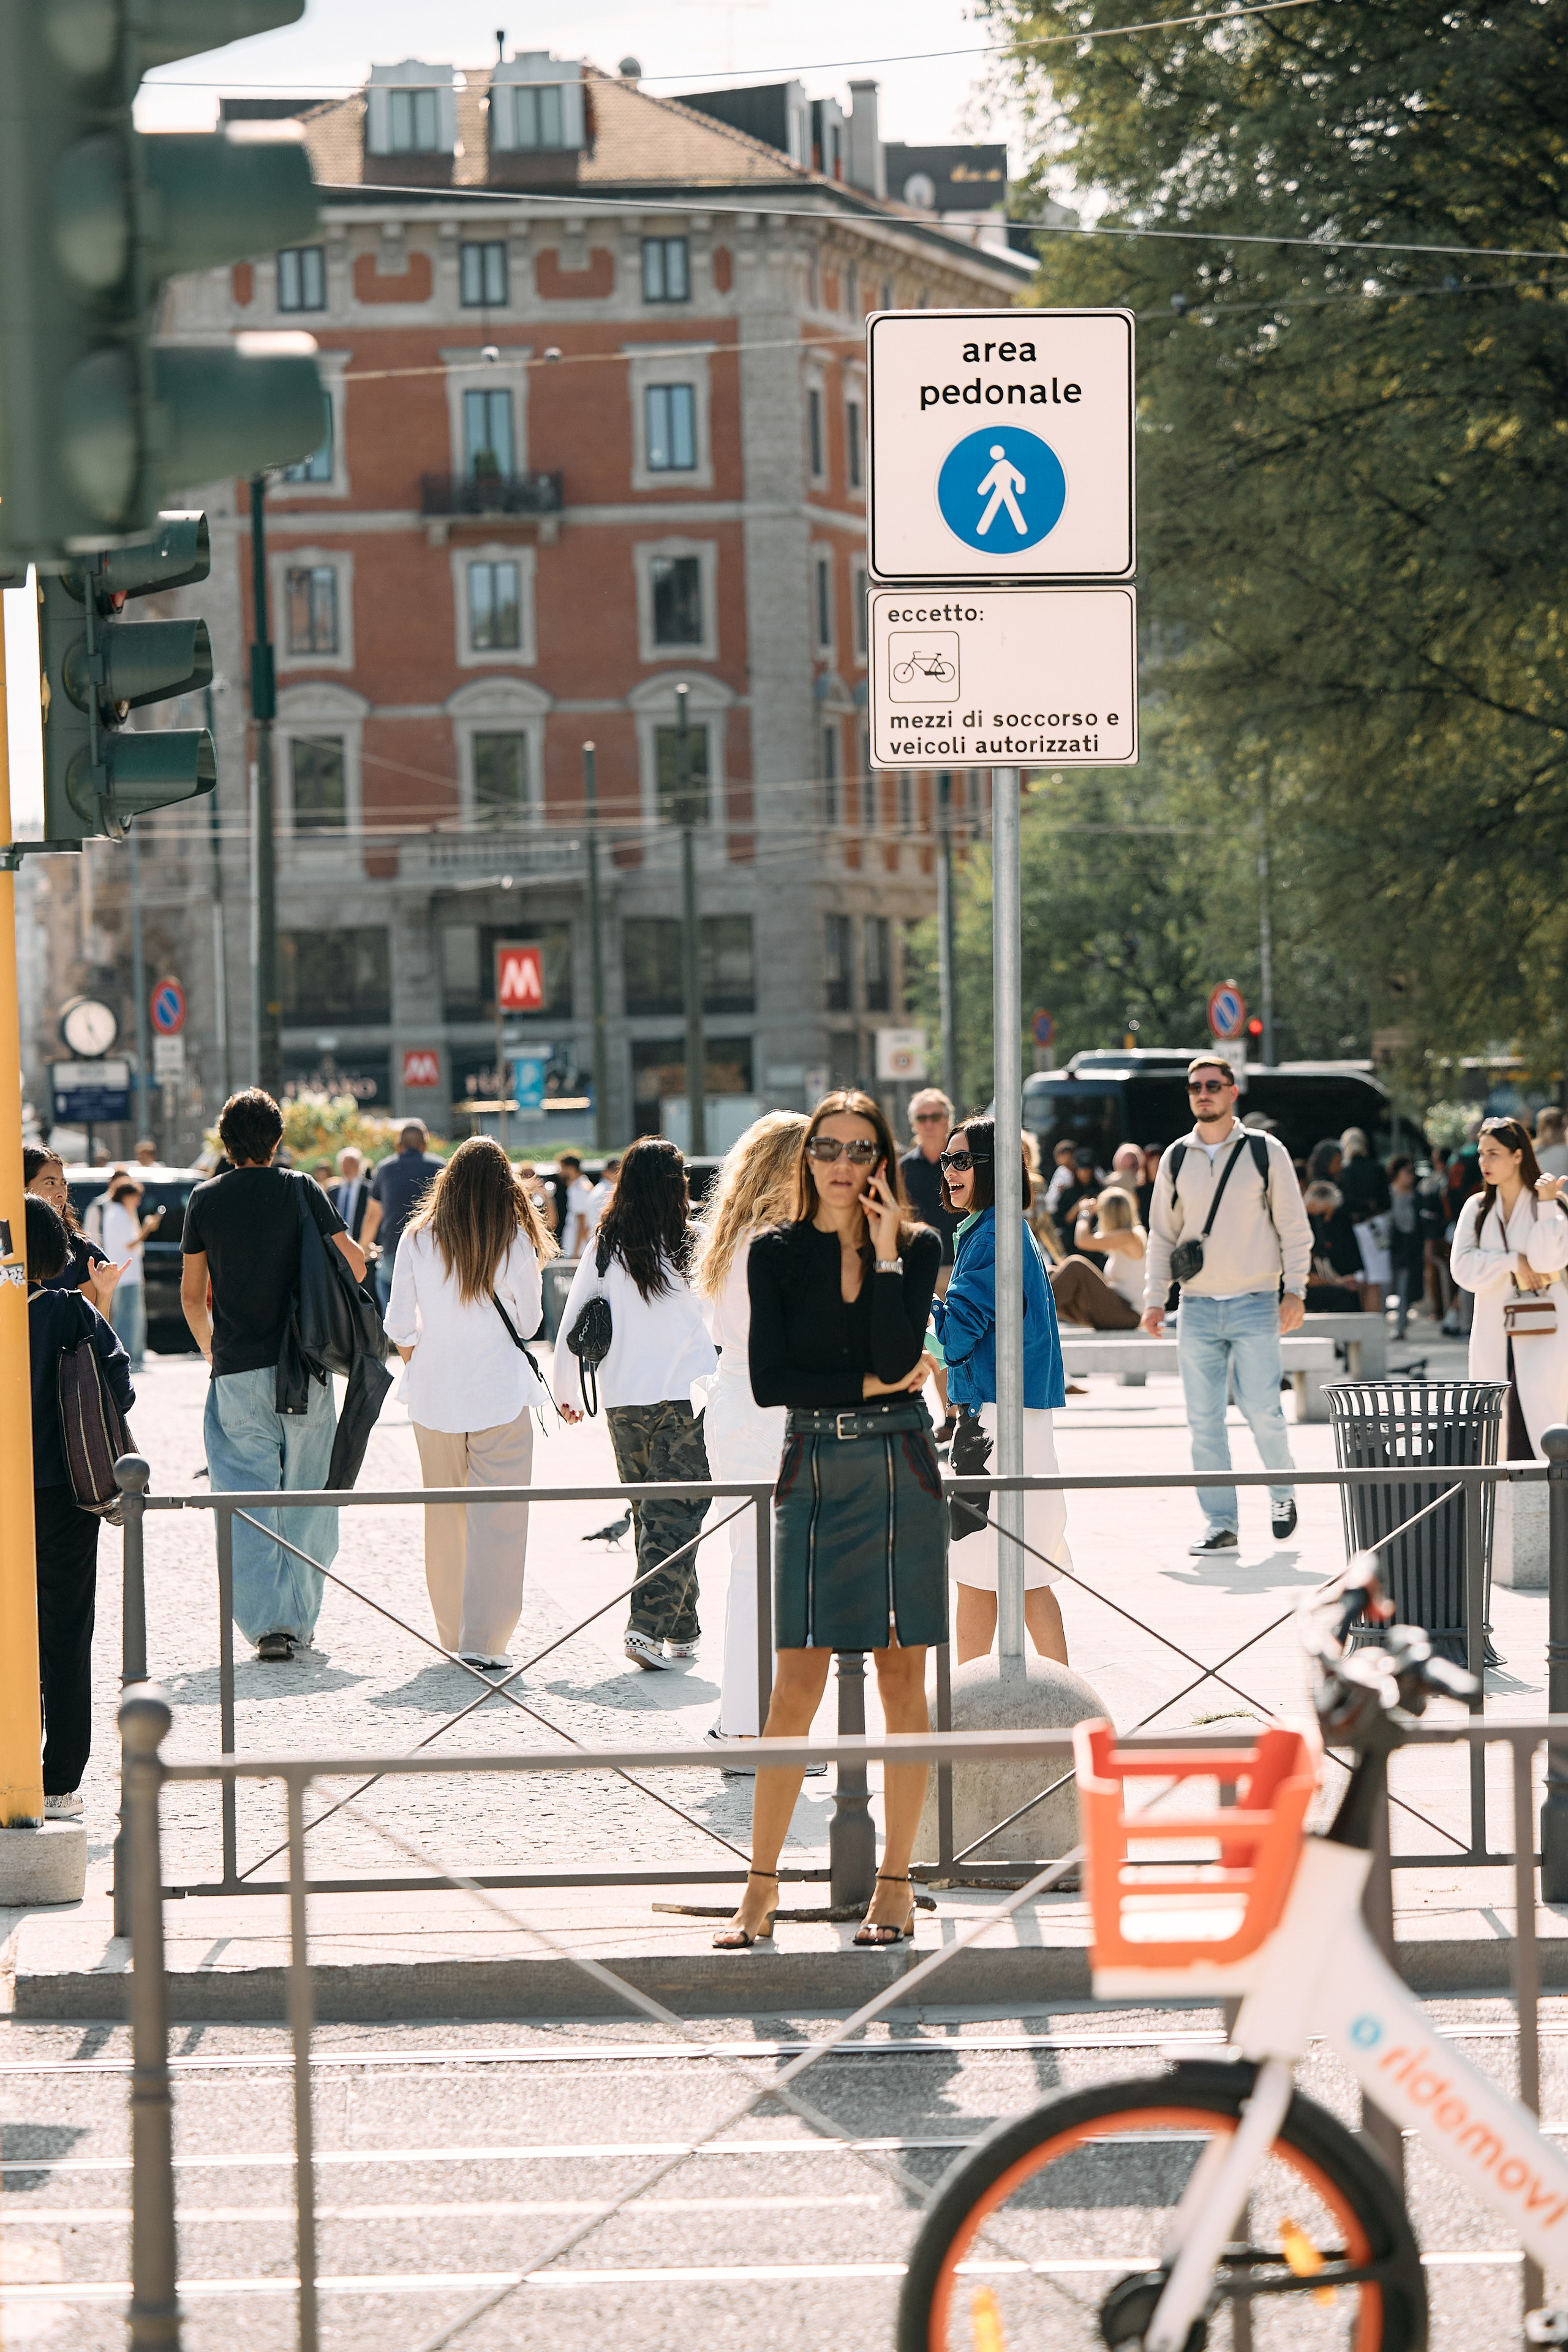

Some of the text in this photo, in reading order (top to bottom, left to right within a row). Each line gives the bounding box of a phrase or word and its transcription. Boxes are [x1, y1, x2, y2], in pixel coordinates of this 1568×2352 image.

[962, 341, 1037, 363] area
[920, 377, 1082, 411] pedonale
[888, 603, 984, 623] eccetto:
[890, 709, 1120, 729] mezzi di soccorso e
[889, 733, 1099, 755] veicoli autorizzati
[499, 956, 541, 1000] M
[404, 1054, 438, 1084] M
[1377, 2045, 1568, 2230] ridemovi
